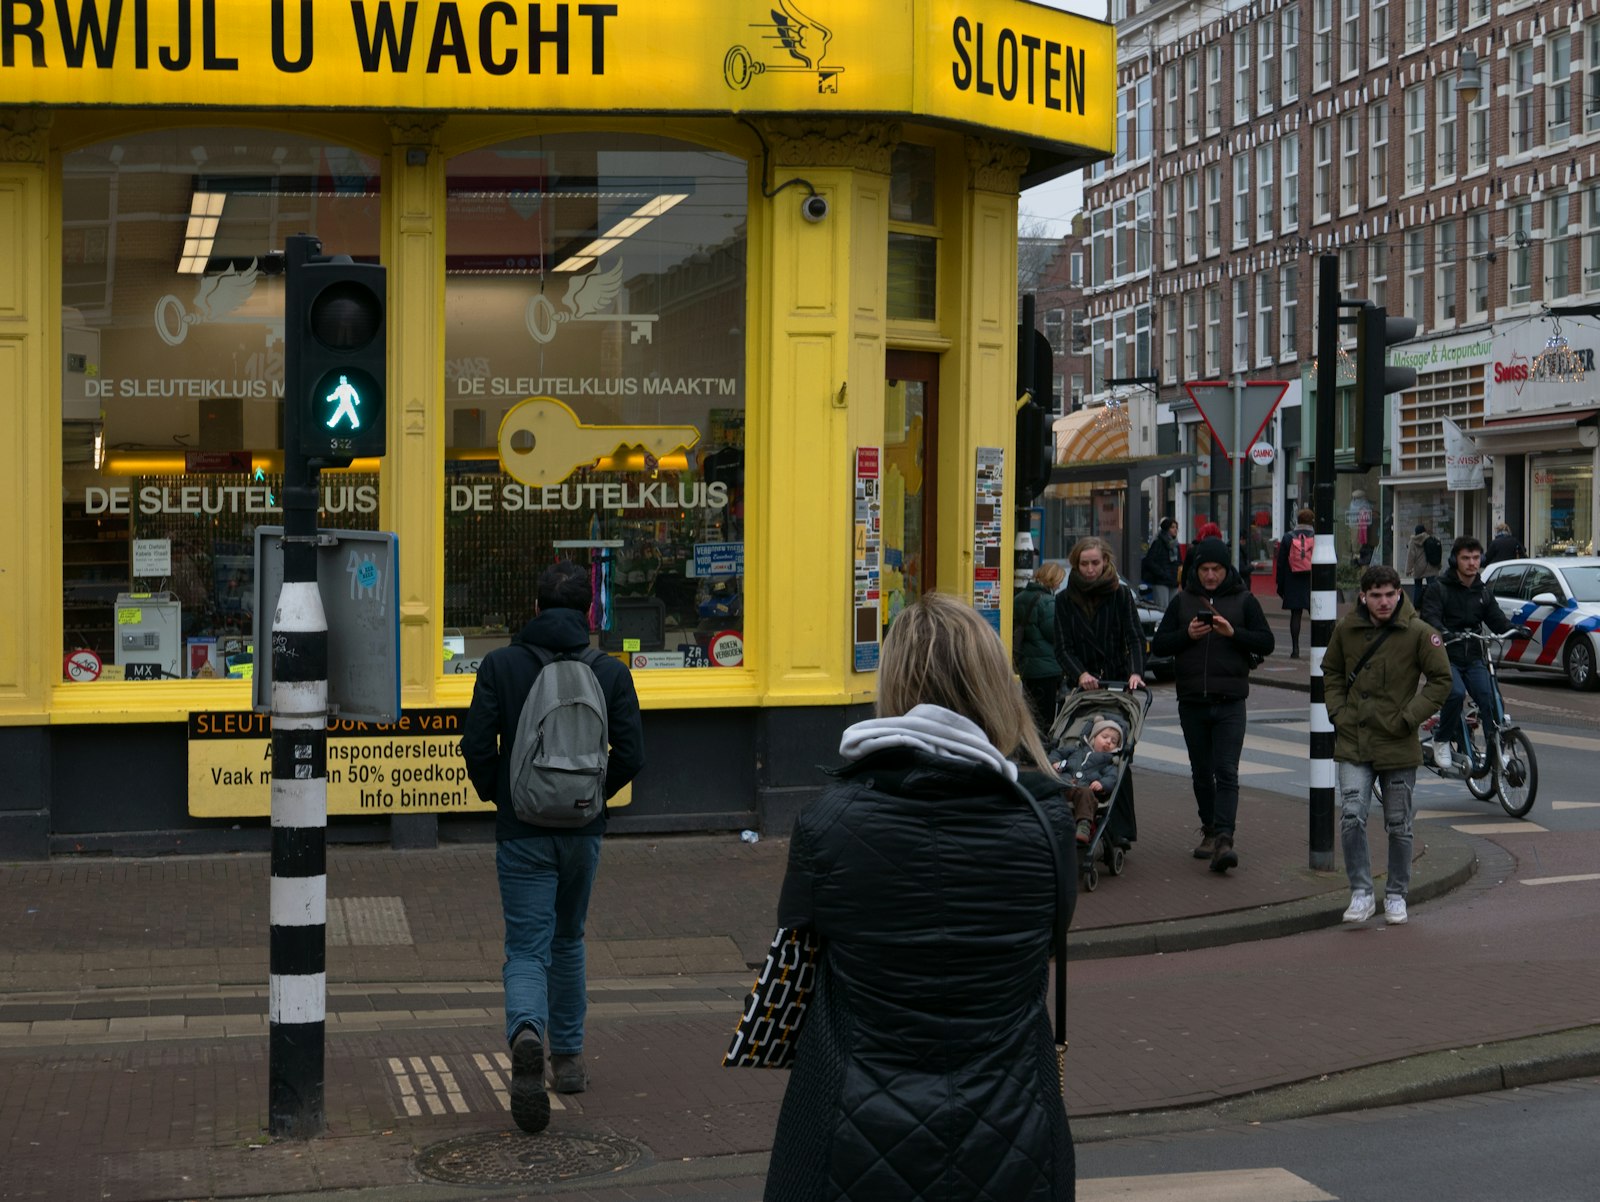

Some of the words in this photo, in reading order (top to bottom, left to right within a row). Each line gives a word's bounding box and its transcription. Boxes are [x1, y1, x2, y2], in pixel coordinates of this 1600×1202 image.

[1, 0, 239, 71] RWIJL
[270, 0, 314, 73] U
[351, 1, 617, 76] WACHT
[952, 16, 1085, 116] SLOTEN
[1393, 351, 1428, 371] Massage
[1431, 344, 1438, 363] &
[84, 379, 114, 397] DE
[457, 378, 485, 395] DE
[490, 377, 638, 395] SLEUTELKLUIS
[643, 377, 736, 395] MAAKT'M
[85, 487, 130, 514] DE
[139, 485, 377, 514] SLEUTELUIS
[451, 485, 493, 512] DE
[501, 481, 729, 511] SLEUTELKLUIS
[134, 664, 153, 676] MX
[197, 714, 272, 733] SLEUT
[419, 714, 457, 730] van
[329, 740, 464, 764] nspondersleute
[211, 767, 253, 785] Vaak
[348, 765, 385, 783] 50%
[391, 764, 470, 787] goedkop
[360, 789, 394, 807] Info
[400, 787, 468, 807] binnen!
